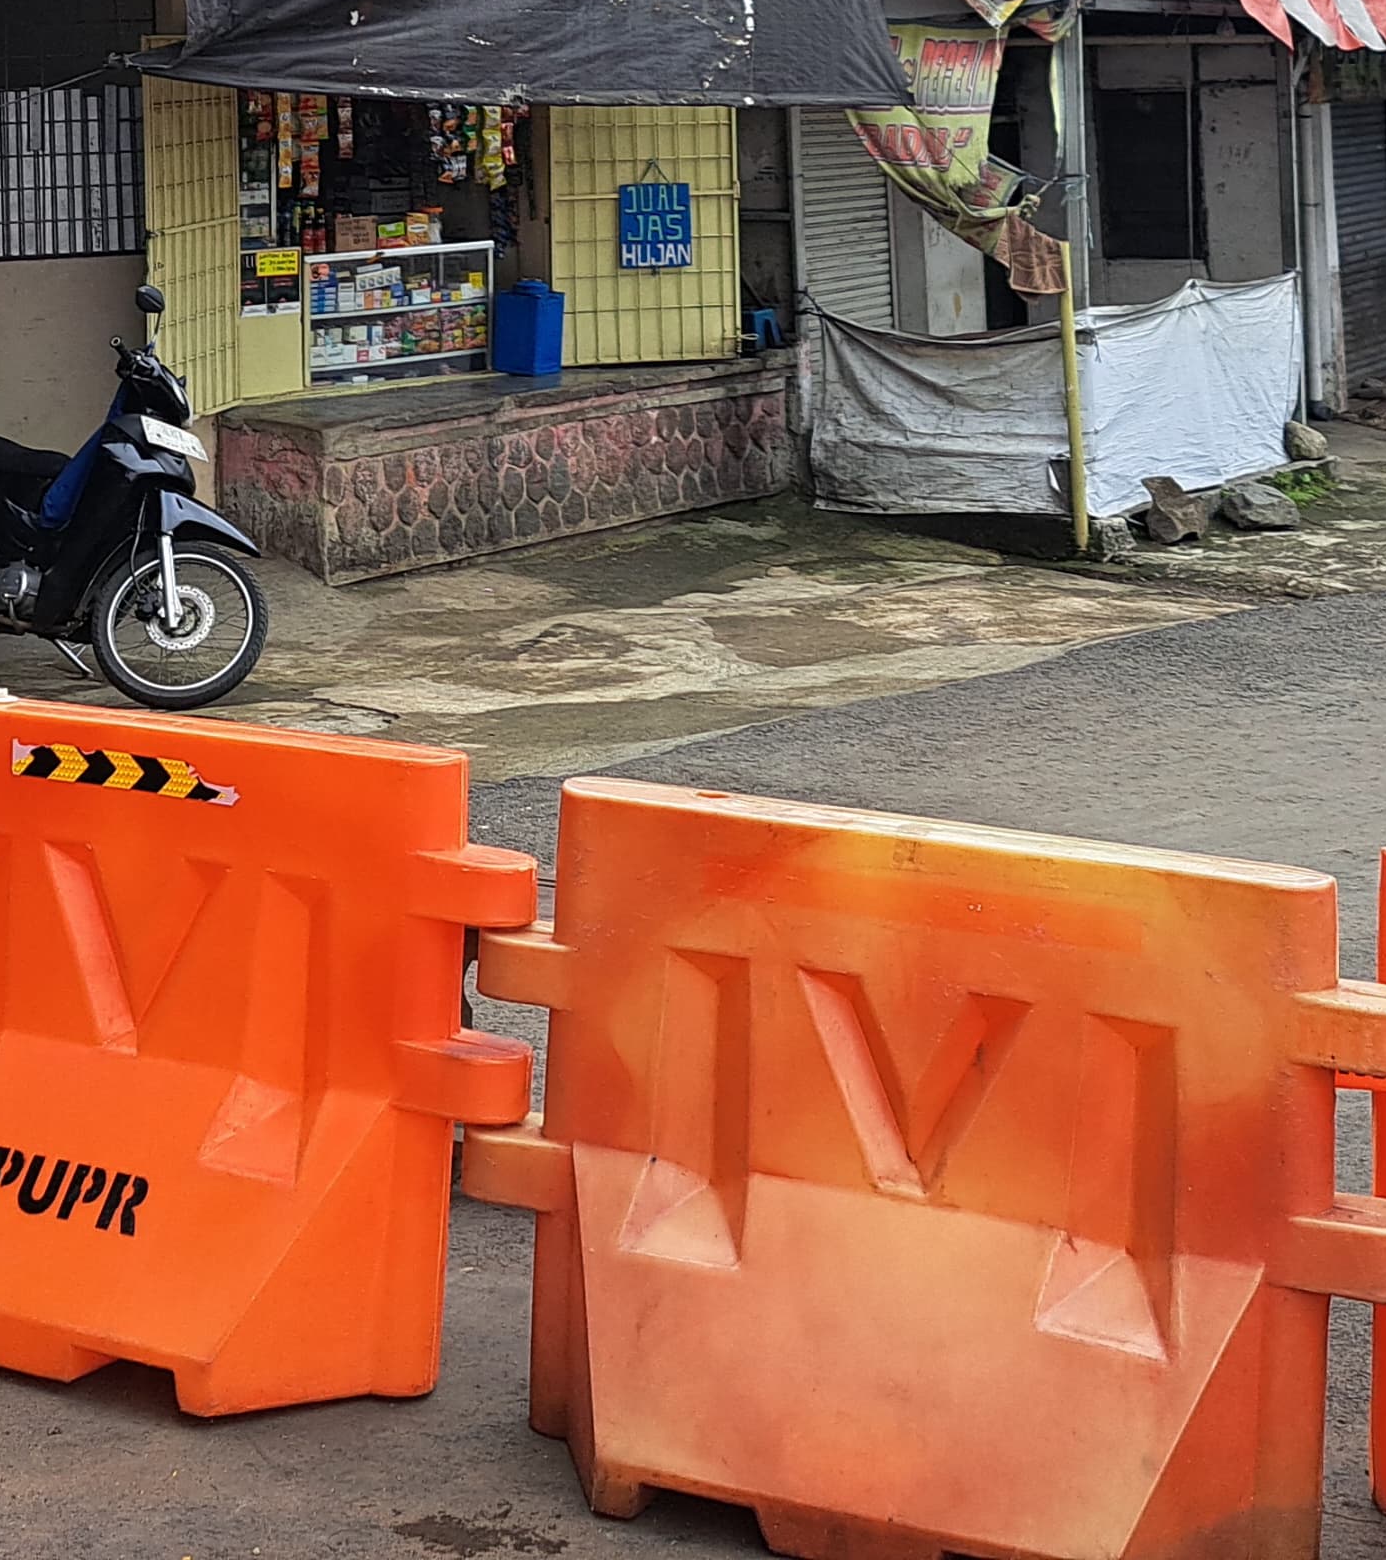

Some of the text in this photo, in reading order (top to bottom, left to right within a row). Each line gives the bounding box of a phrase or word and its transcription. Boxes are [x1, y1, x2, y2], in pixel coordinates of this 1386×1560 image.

[624, 184, 686, 213] JUAL
[627, 214, 683, 241] JAS
[621, 243, 692, 267] HUJAN
